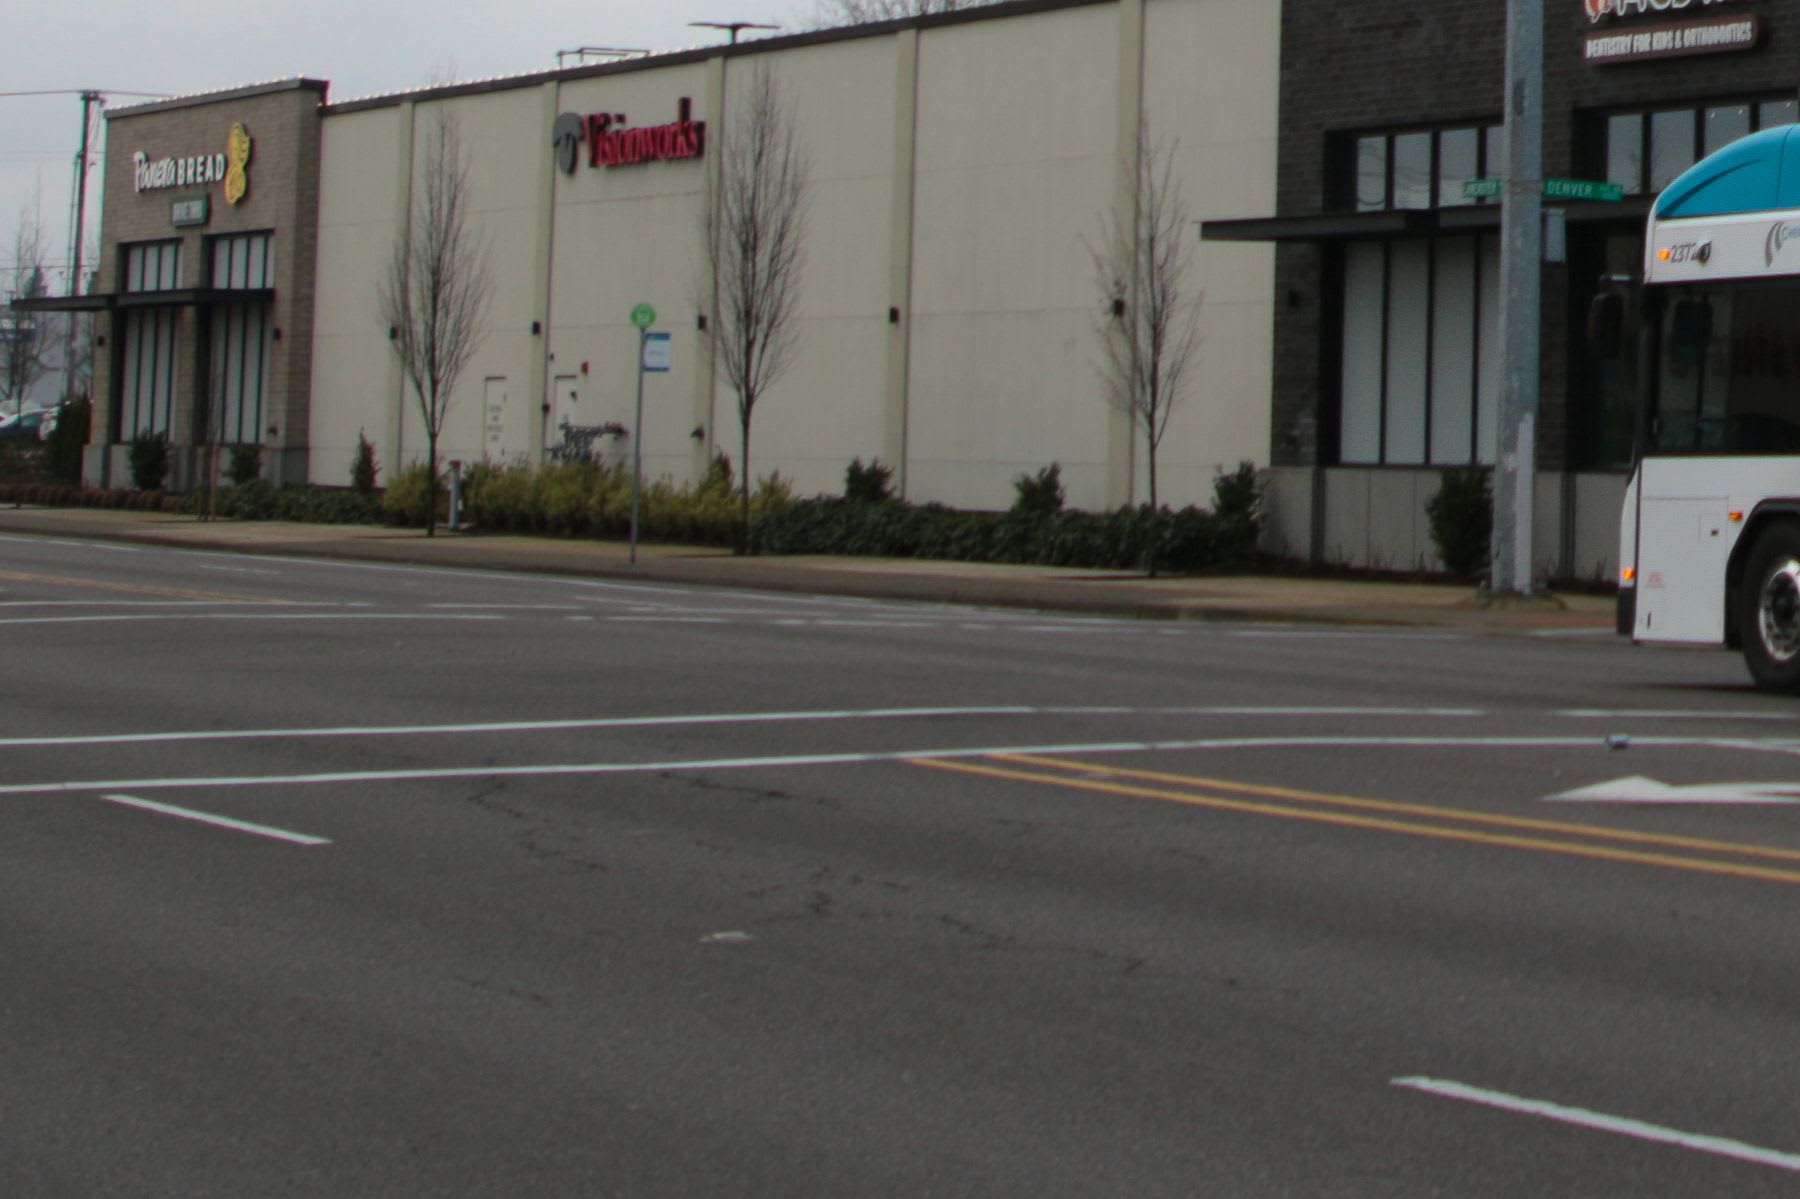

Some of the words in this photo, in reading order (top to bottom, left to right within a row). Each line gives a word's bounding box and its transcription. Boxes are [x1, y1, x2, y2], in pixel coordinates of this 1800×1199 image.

[1586, 34, 1632, 58] DENTISTRY
[1633, 32, 1651, 54] FOR
[1652, 30, 1674, 51] KIDS
[580, 97, 703, 168] Visionworks
[133, 151, 176, 193] Panera
[177, 153, 225, 186] BREAD
[1547, 181, 1593, 196] DENVER
